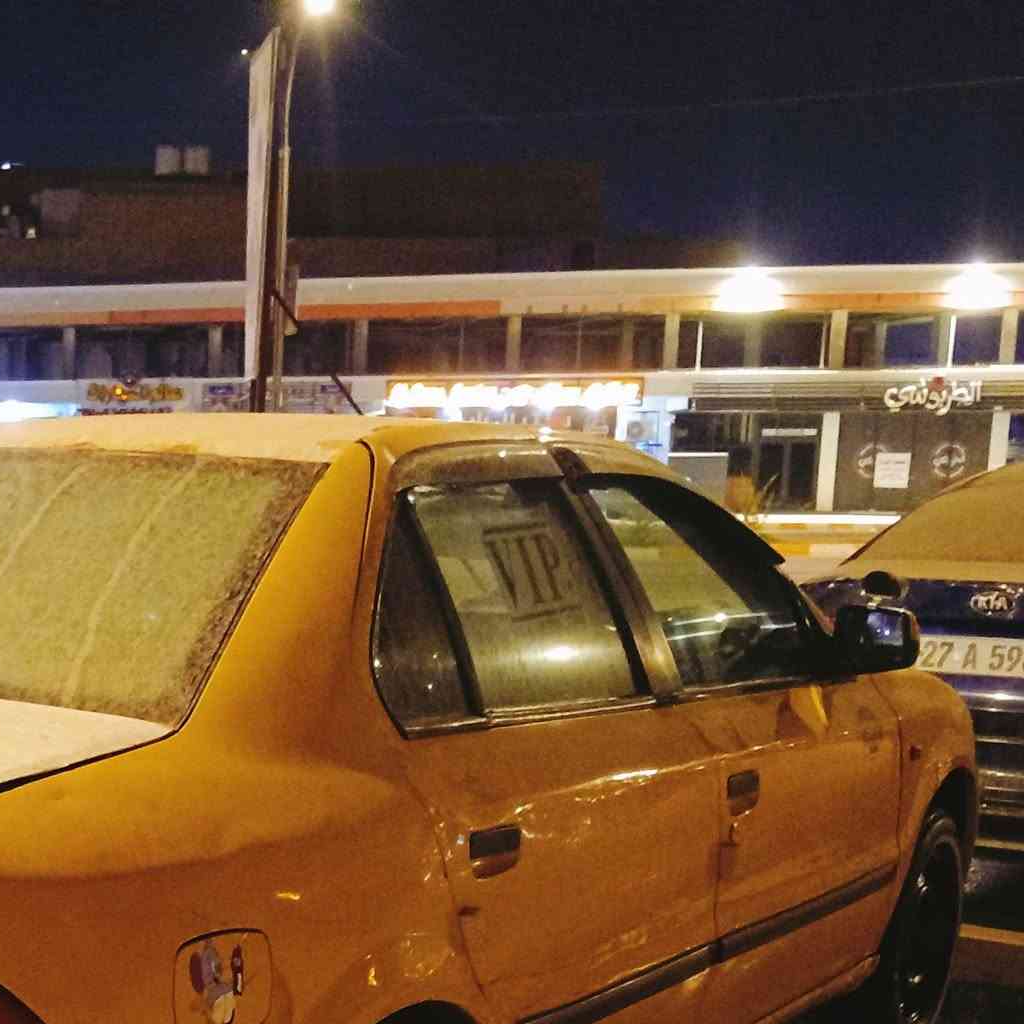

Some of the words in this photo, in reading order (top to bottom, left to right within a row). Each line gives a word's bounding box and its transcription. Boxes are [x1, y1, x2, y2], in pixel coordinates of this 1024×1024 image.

[483, 532, 564, 608] VIP
[961, 641, 977, 670] A
[988, 645, 1024, 672] 59
